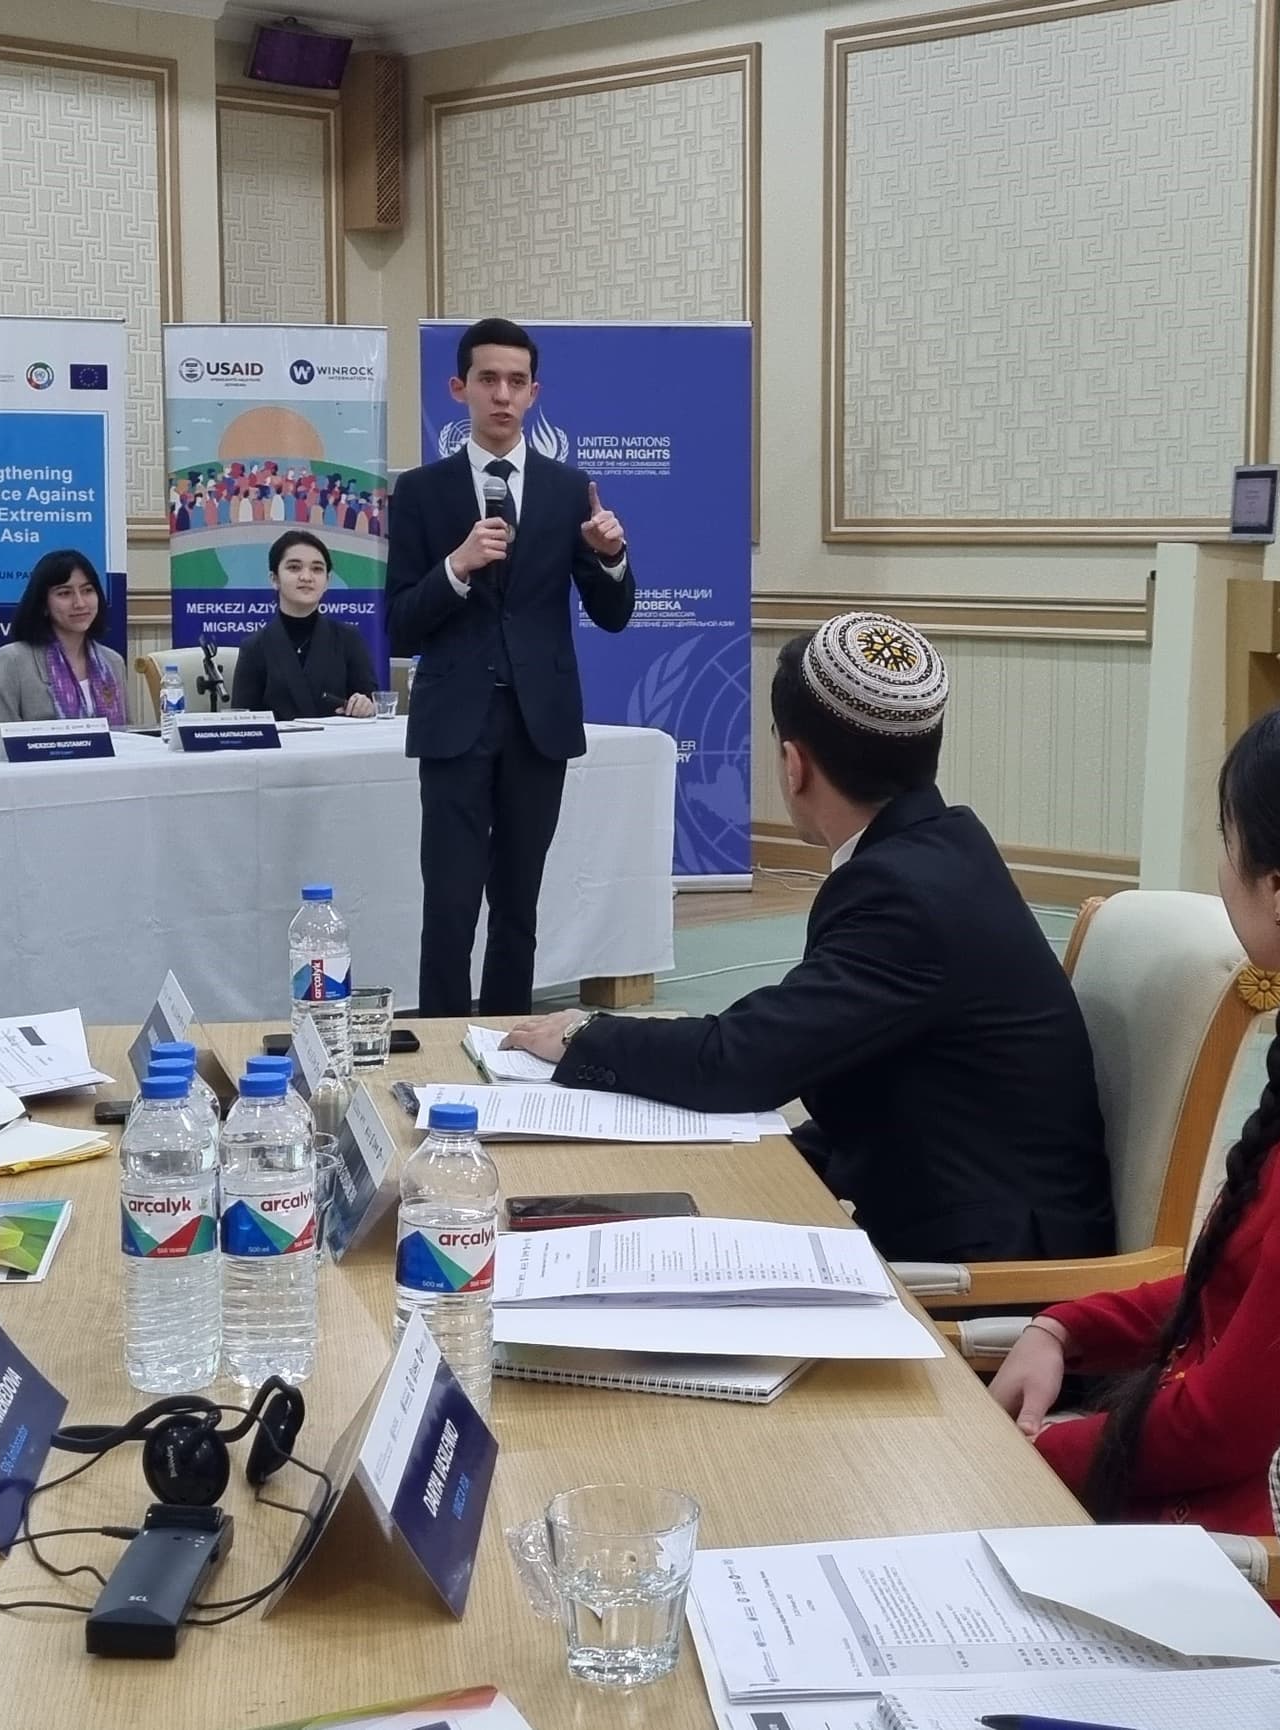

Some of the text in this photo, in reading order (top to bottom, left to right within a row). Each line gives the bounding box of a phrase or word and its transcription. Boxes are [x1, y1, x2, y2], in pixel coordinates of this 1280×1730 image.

[206, 362, 263, 376] USAID
[316, 366, 374, 376] WINROCK
[577, 436, 671, 447] UNITED NATIONS
[577, 449, 671, 460] HUMAN RIGHTS
[26, 487, 95, 505] Against
[0, 528, 40, 543] Asia
[673, 588, 713, 600] НАЦИИ
[186, 601, 375, 614] MERKEZI AZIÝ OWPSUZ
[633, 600, 682, 610] ЛОВЕКА
[203, 619, 267, 632] MIGRASIÝ
[312, 961, 323, 999] arçalyk
[129, 1196, 191, 1216] arçalyk
[422, 1280, 435, 1288] 500
[423, 1418, 459, 1518] DARYA VASILENKO
